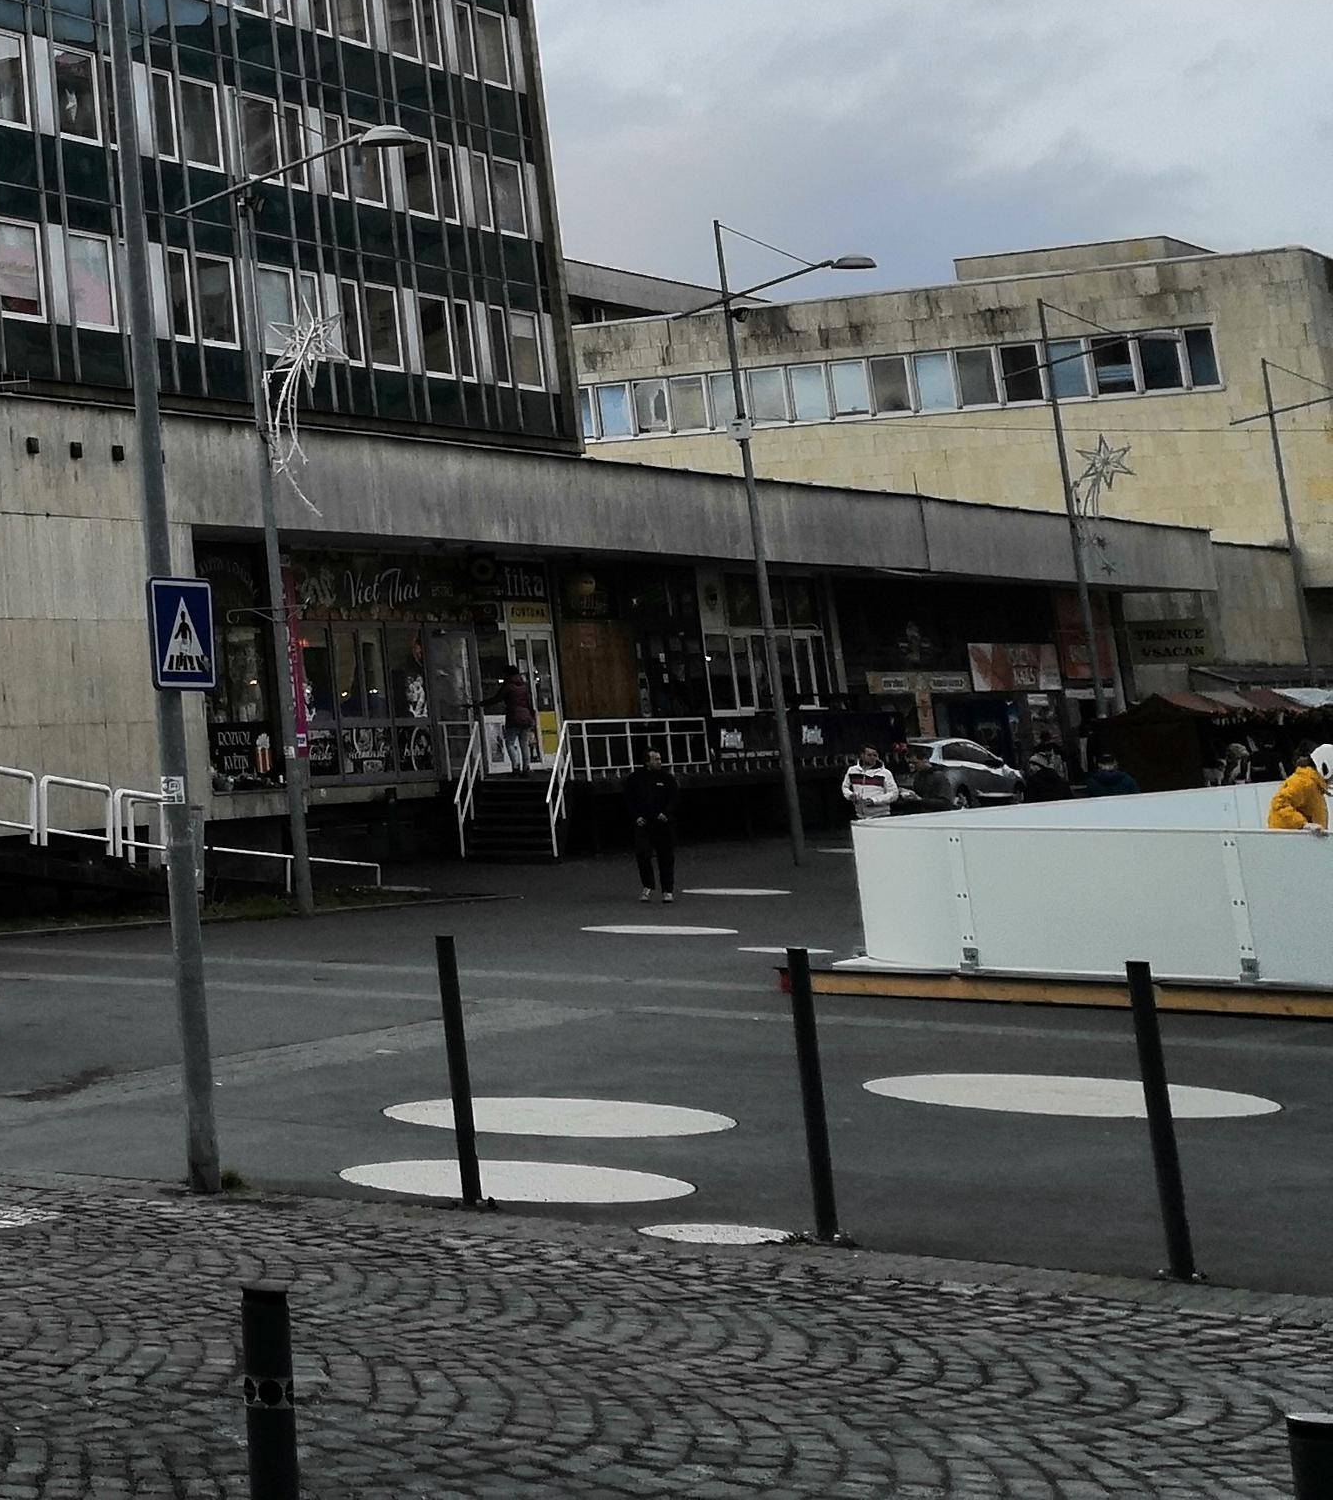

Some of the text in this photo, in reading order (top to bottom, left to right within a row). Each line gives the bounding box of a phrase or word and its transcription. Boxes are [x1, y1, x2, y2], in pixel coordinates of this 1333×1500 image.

[344, 567, 421, 608] Viet Thai
[217, 731, 252, 747] ROZVOZ
